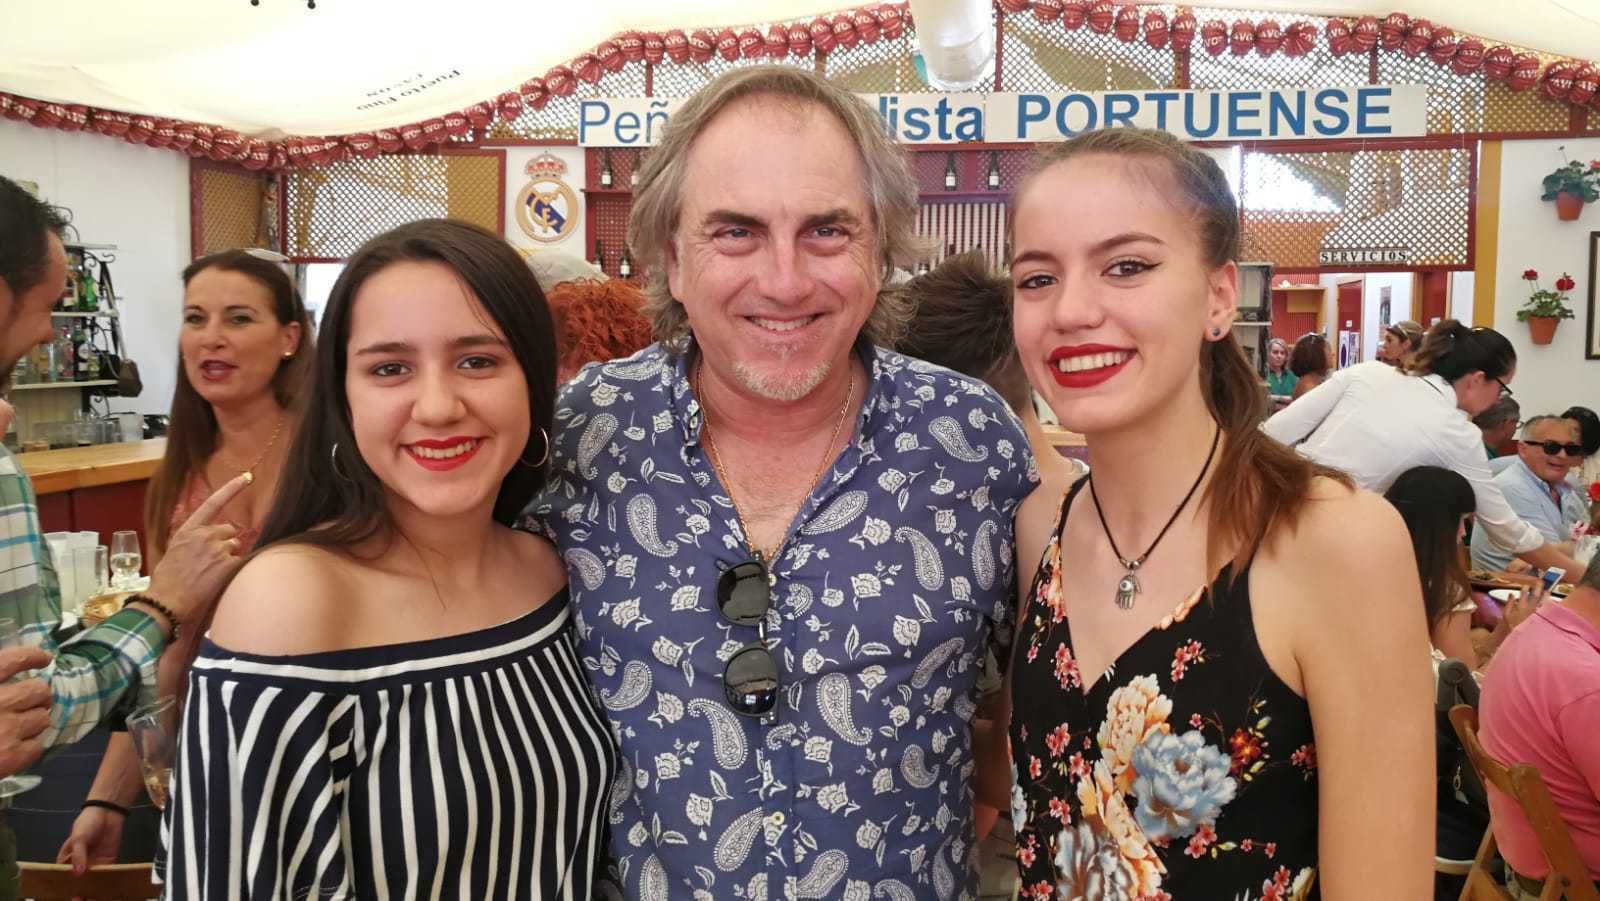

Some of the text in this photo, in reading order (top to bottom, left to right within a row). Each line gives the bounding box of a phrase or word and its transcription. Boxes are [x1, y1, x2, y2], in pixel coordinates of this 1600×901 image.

[579, 101, 670, 144] Peñ
[1018, 87, 1392, 140] PORTUENSE
[1321, 250, 1407, 263] SERVICIOS
